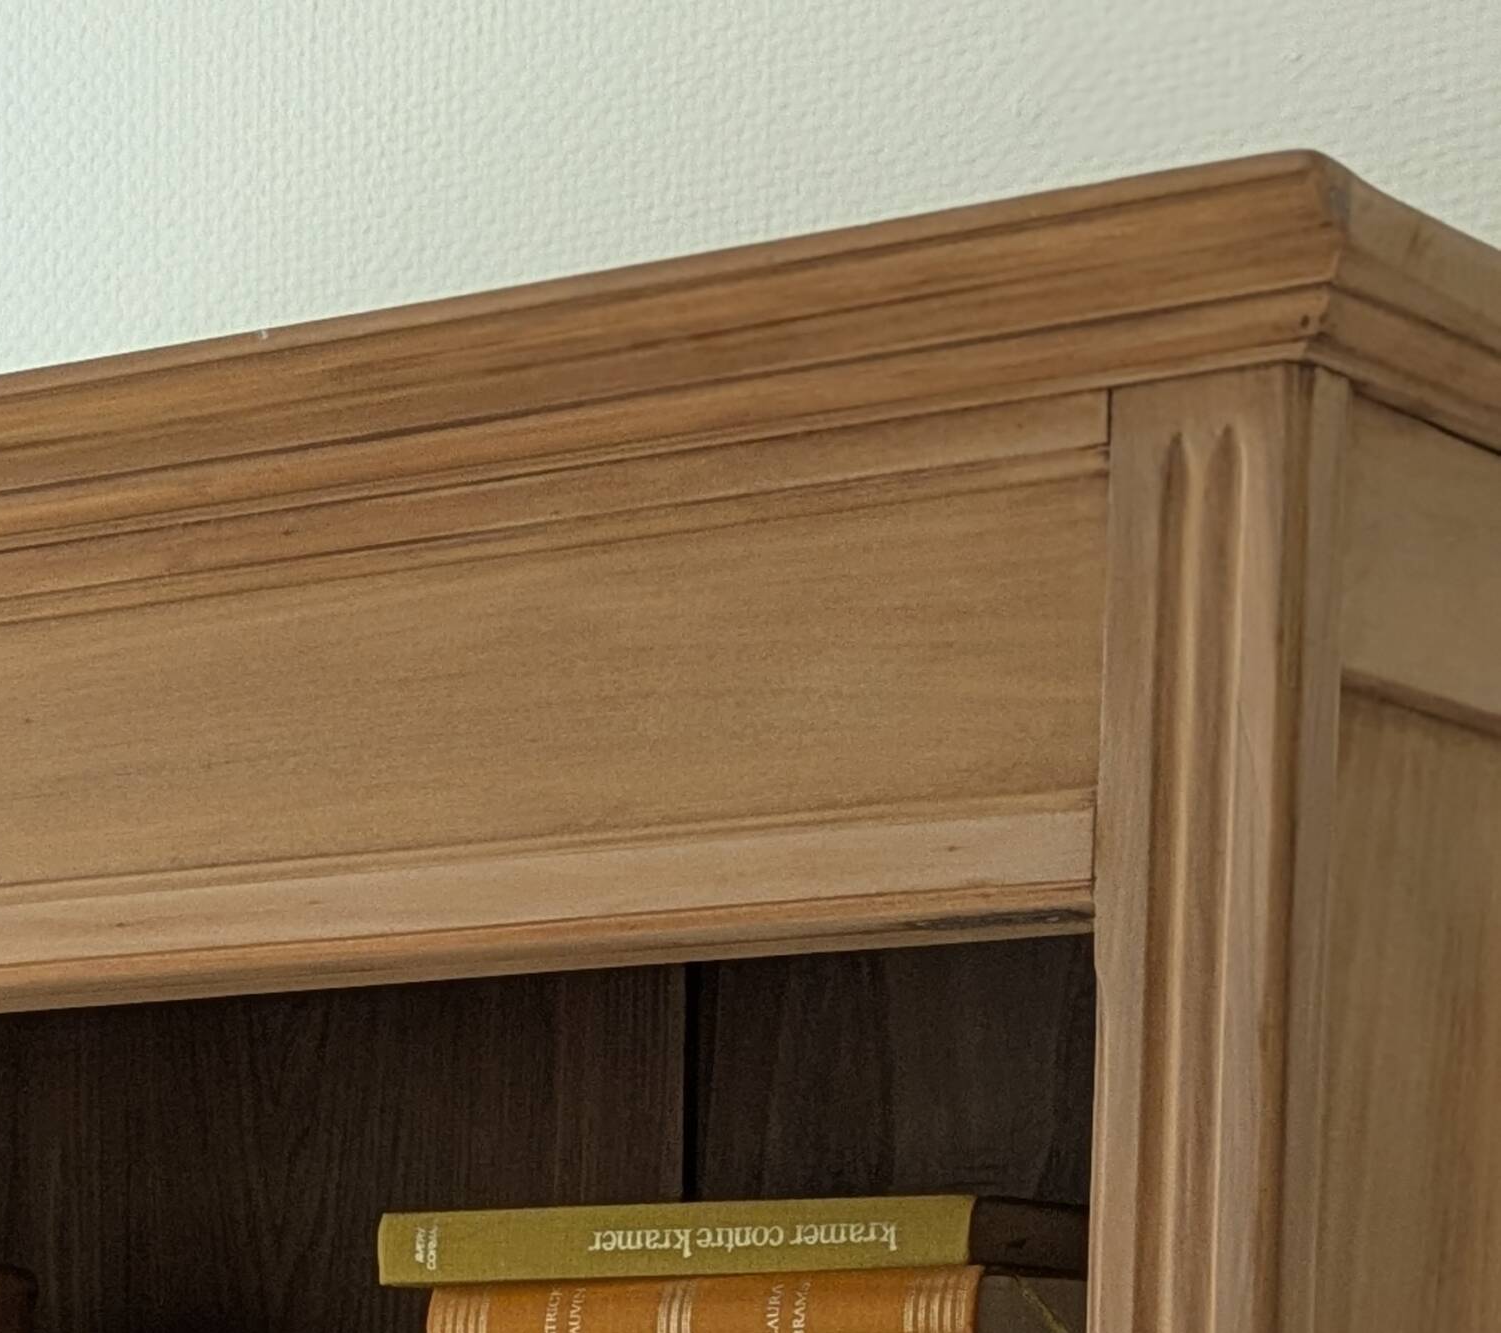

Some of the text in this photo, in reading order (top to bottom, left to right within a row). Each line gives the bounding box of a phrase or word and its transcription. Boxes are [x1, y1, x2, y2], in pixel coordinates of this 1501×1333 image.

[587, 1220, 898, 1259] kramer contre kramer
